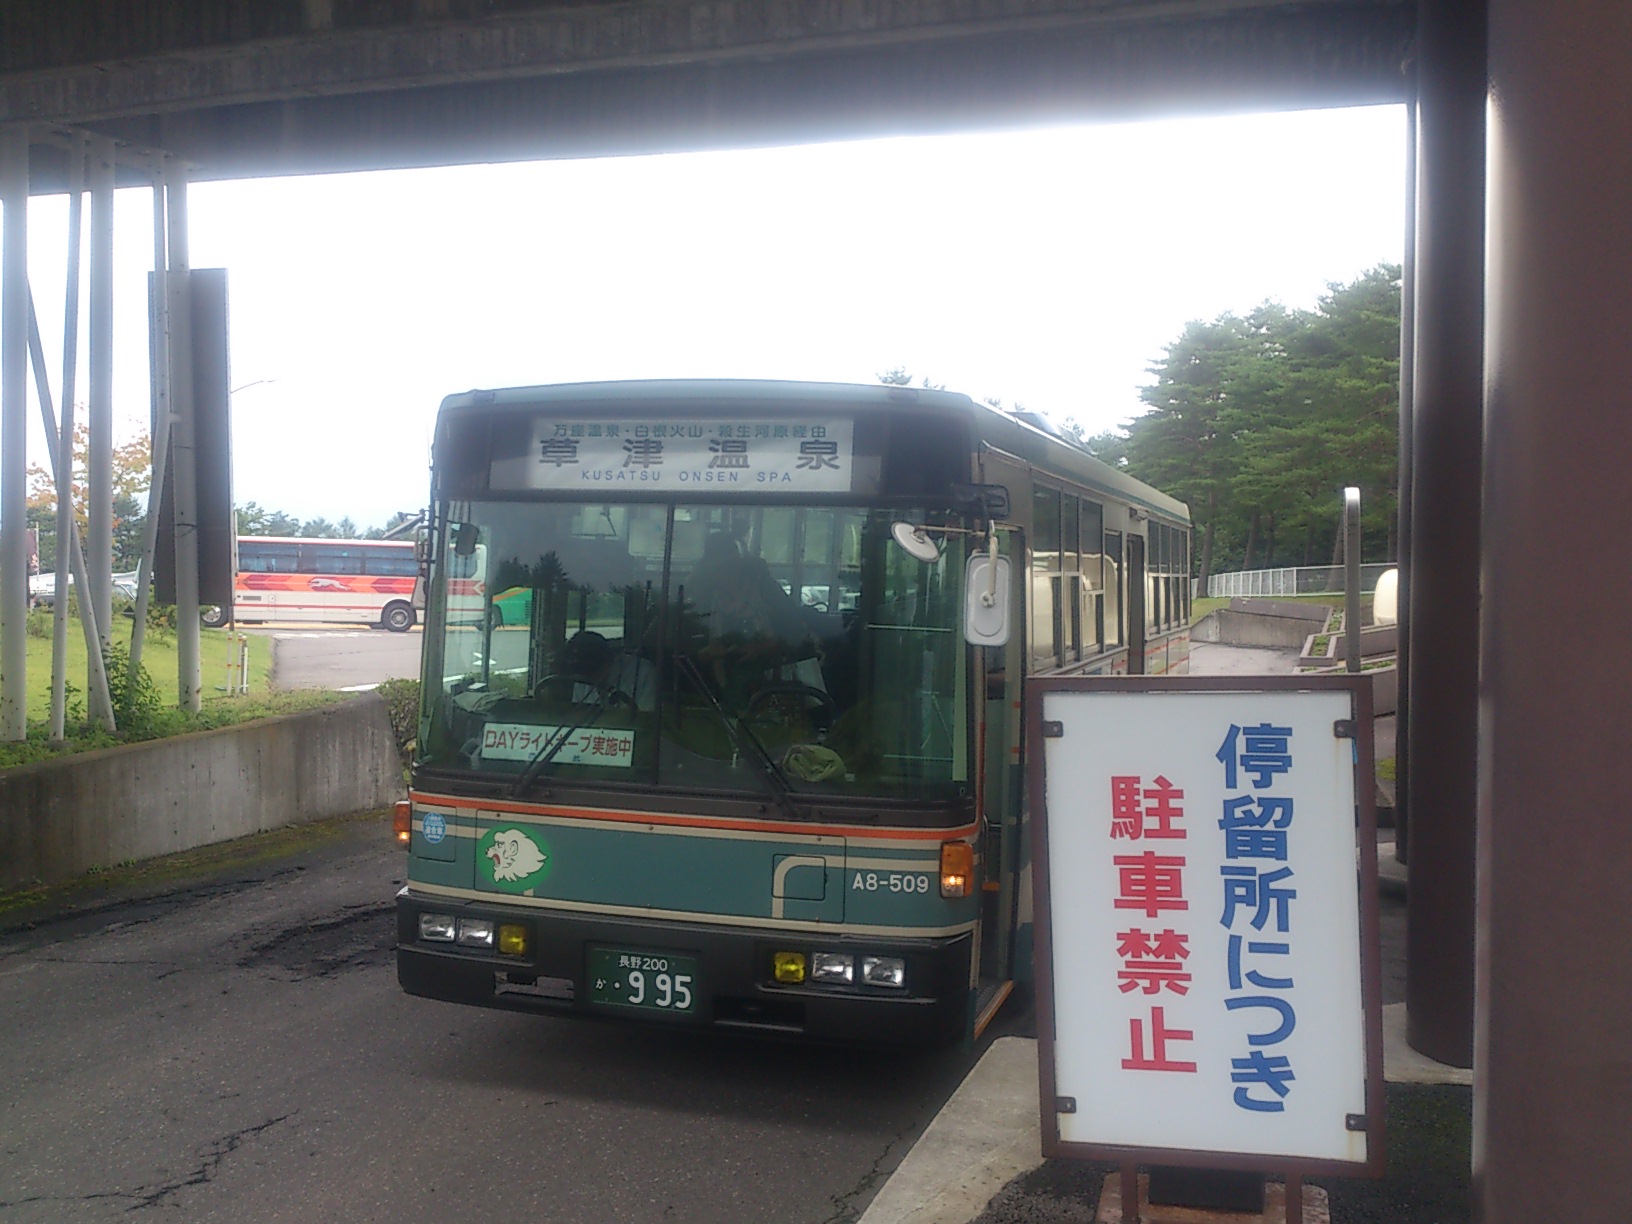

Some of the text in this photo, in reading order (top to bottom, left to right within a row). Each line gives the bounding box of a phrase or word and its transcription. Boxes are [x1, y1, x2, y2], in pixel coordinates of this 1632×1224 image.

[539, 439, 840, 470] 草津温泉
[581, 470, 792, 483] KUSATSU ONSEN SPA
[852, 871, 930, 894] A8-509
[1109, 774, 1199, 1074] 駐車禁止
[1215, 722, 1298, 1113] 停留所につき
